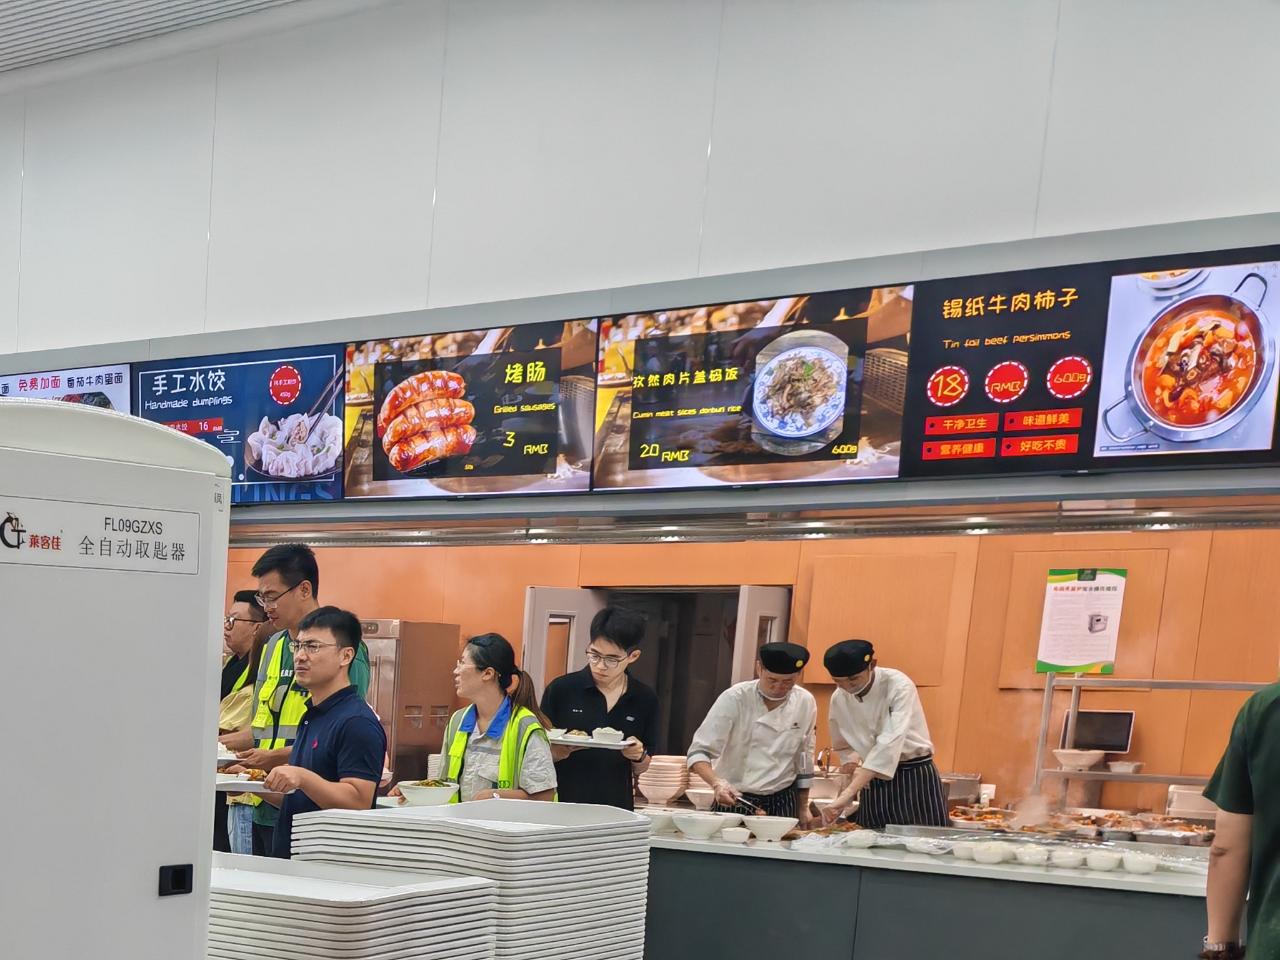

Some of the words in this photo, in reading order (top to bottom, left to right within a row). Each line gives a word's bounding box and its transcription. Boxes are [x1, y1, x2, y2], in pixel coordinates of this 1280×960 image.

[943, 288, 1078, 320] 锡纸牛肉柿子
[943, 338, 960, 350] Tin
[985, 334, 1008, 346] beef
[1012, 330, 1072, 345] persimmons
[504, 361, 546, 384] 烤肠
[632, 367, 739, 388] 孜然肉片盖码饭
[1053, 372, 1087, 385] 600g
[18, 375, 61, 392] 免费加面
[152, 369, 226, 396] 手工水饺
[933, 373, 964, 398] 18
[991, 381, 1021, 393] RMB
[145, 398, 188, 410] Handmade
[192, 395, 233, 407] dumplings
[493, 403, 518, 415] Grilled
[520, 401, 556, 413] sausages
[199, 421, 209, 431] 16
[943, 417, 987, 430] 干净卫生
[1023, 413, 1070, 426] 味道鲜美
[502, 431, 515, 448] 3
[1020, 439, 1066, 452] 好吃不贵
[523, 443, 549, 455] RMB
[640, 443, 659, 459] 20
[661, 450, 689, 462] RMB
[940, 443, 984, 455] 营养健康
[104, 516, 163, 535] FL09GZXS
[78, 536, 186, 561] 全自动取匙器
